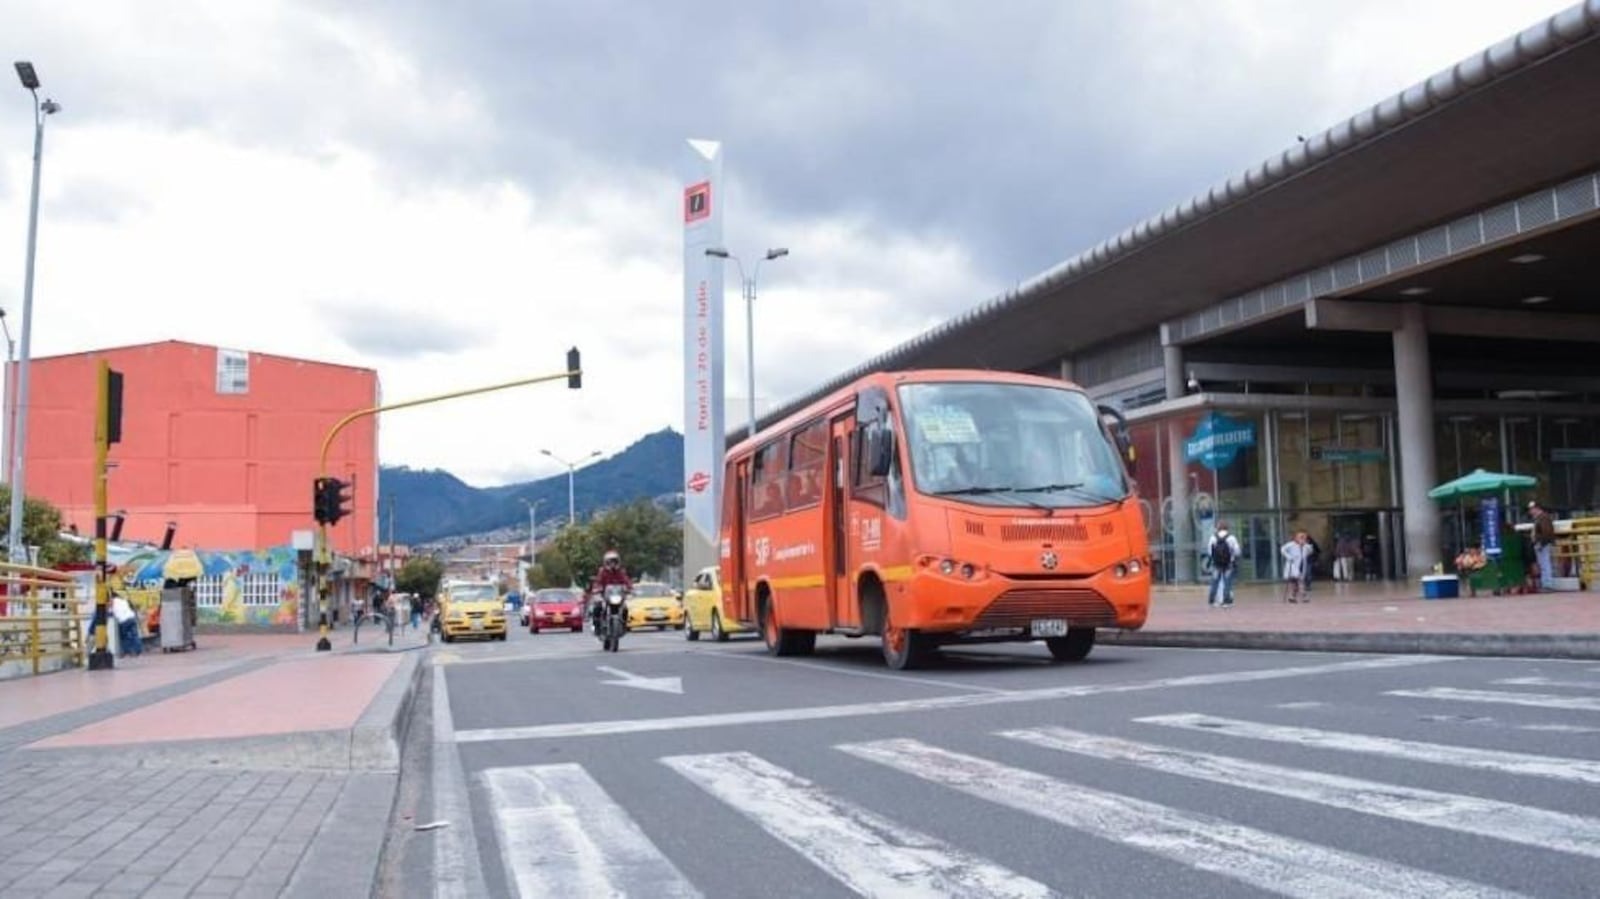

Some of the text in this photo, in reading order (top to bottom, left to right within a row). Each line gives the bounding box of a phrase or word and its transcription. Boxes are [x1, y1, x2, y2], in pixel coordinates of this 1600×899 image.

[698, 326, 708, 348] de
[698, 351, 708, 371] 20
[697, 380, 708, 430] Portal
